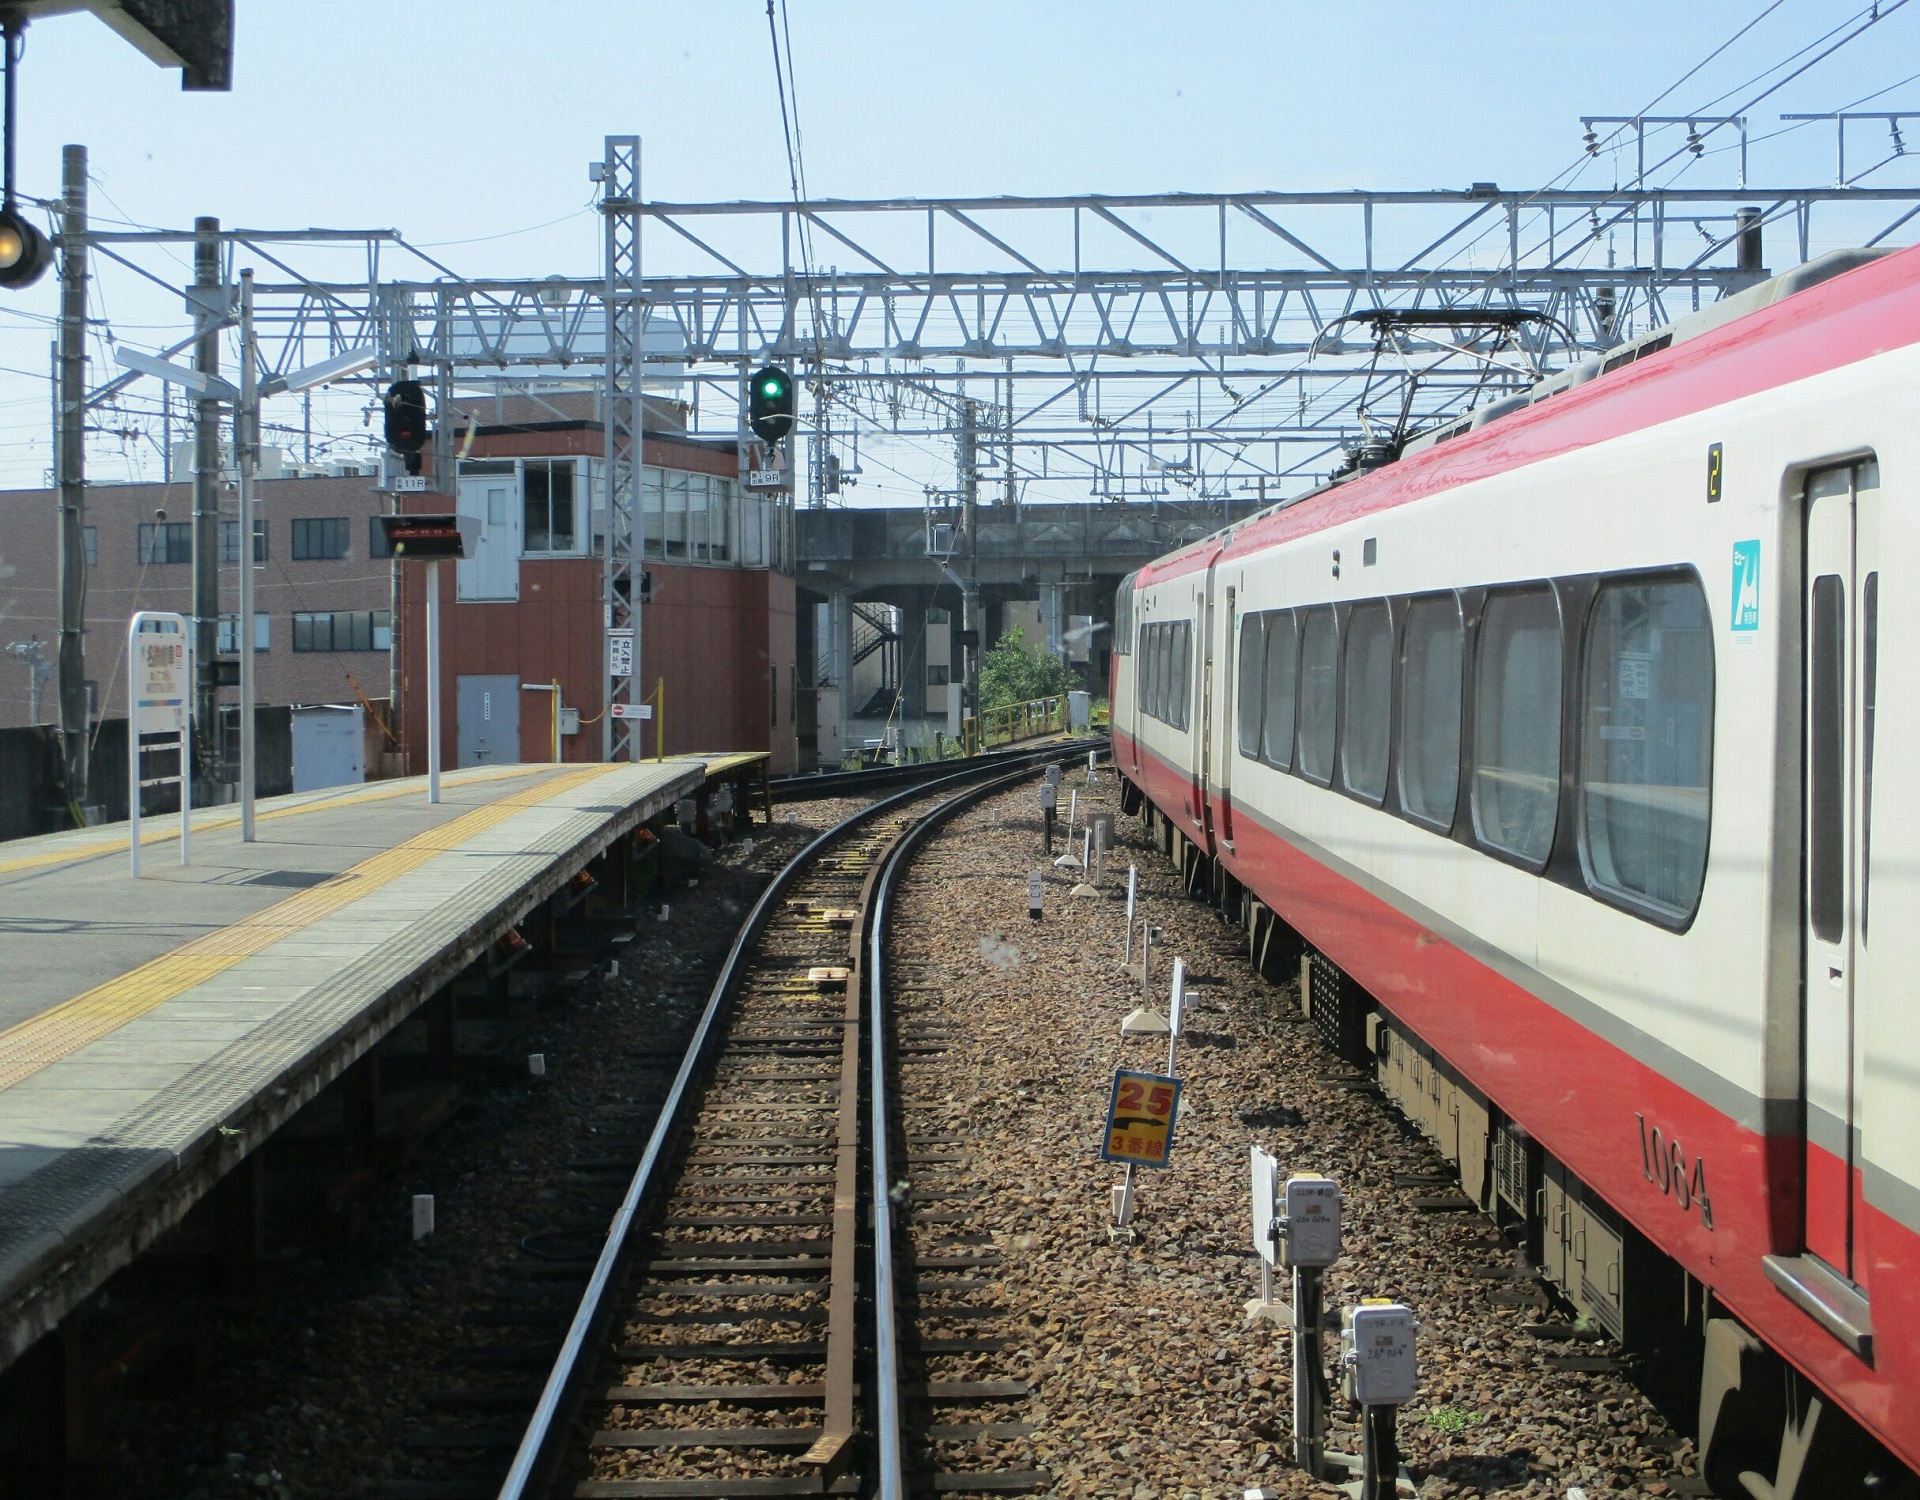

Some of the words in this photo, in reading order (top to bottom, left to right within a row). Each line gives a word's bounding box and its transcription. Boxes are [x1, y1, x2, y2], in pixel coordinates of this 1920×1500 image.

[405, 480, 424, 488] 11R
[765, 474, 779, 482] 9R
[1710, 450, 1720, 496] 2
[620, 640, 631, 675] 立入禁止
[1116, 1082, 1174, 1116] 25
[1111, 1135, 1164, 1158] 3番線
[1634, 1111, 1714, 1232] 1064
